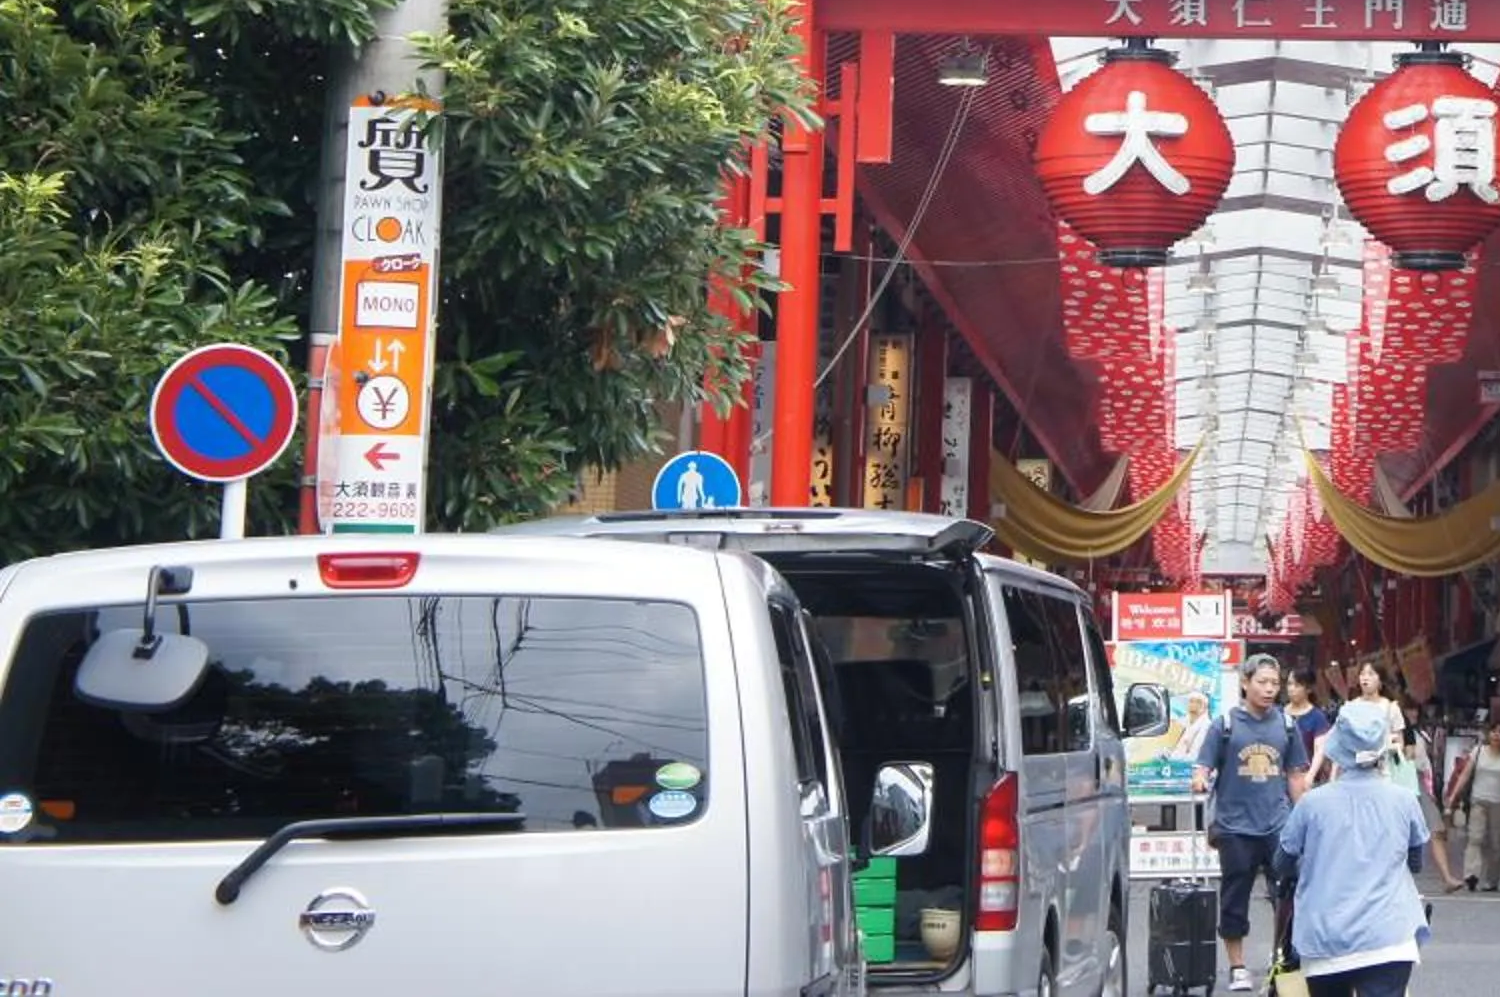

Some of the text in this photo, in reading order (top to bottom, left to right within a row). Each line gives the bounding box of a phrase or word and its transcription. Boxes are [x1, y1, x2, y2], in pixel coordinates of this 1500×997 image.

[358, 117, 429, 193] 質
[1082, 90, 1191, 195] 大
[354, 194, 429, 212] PAWN SHOP
[352, 216, 425, 245] CLOAK
[362, 295, 416, 314] MONO
